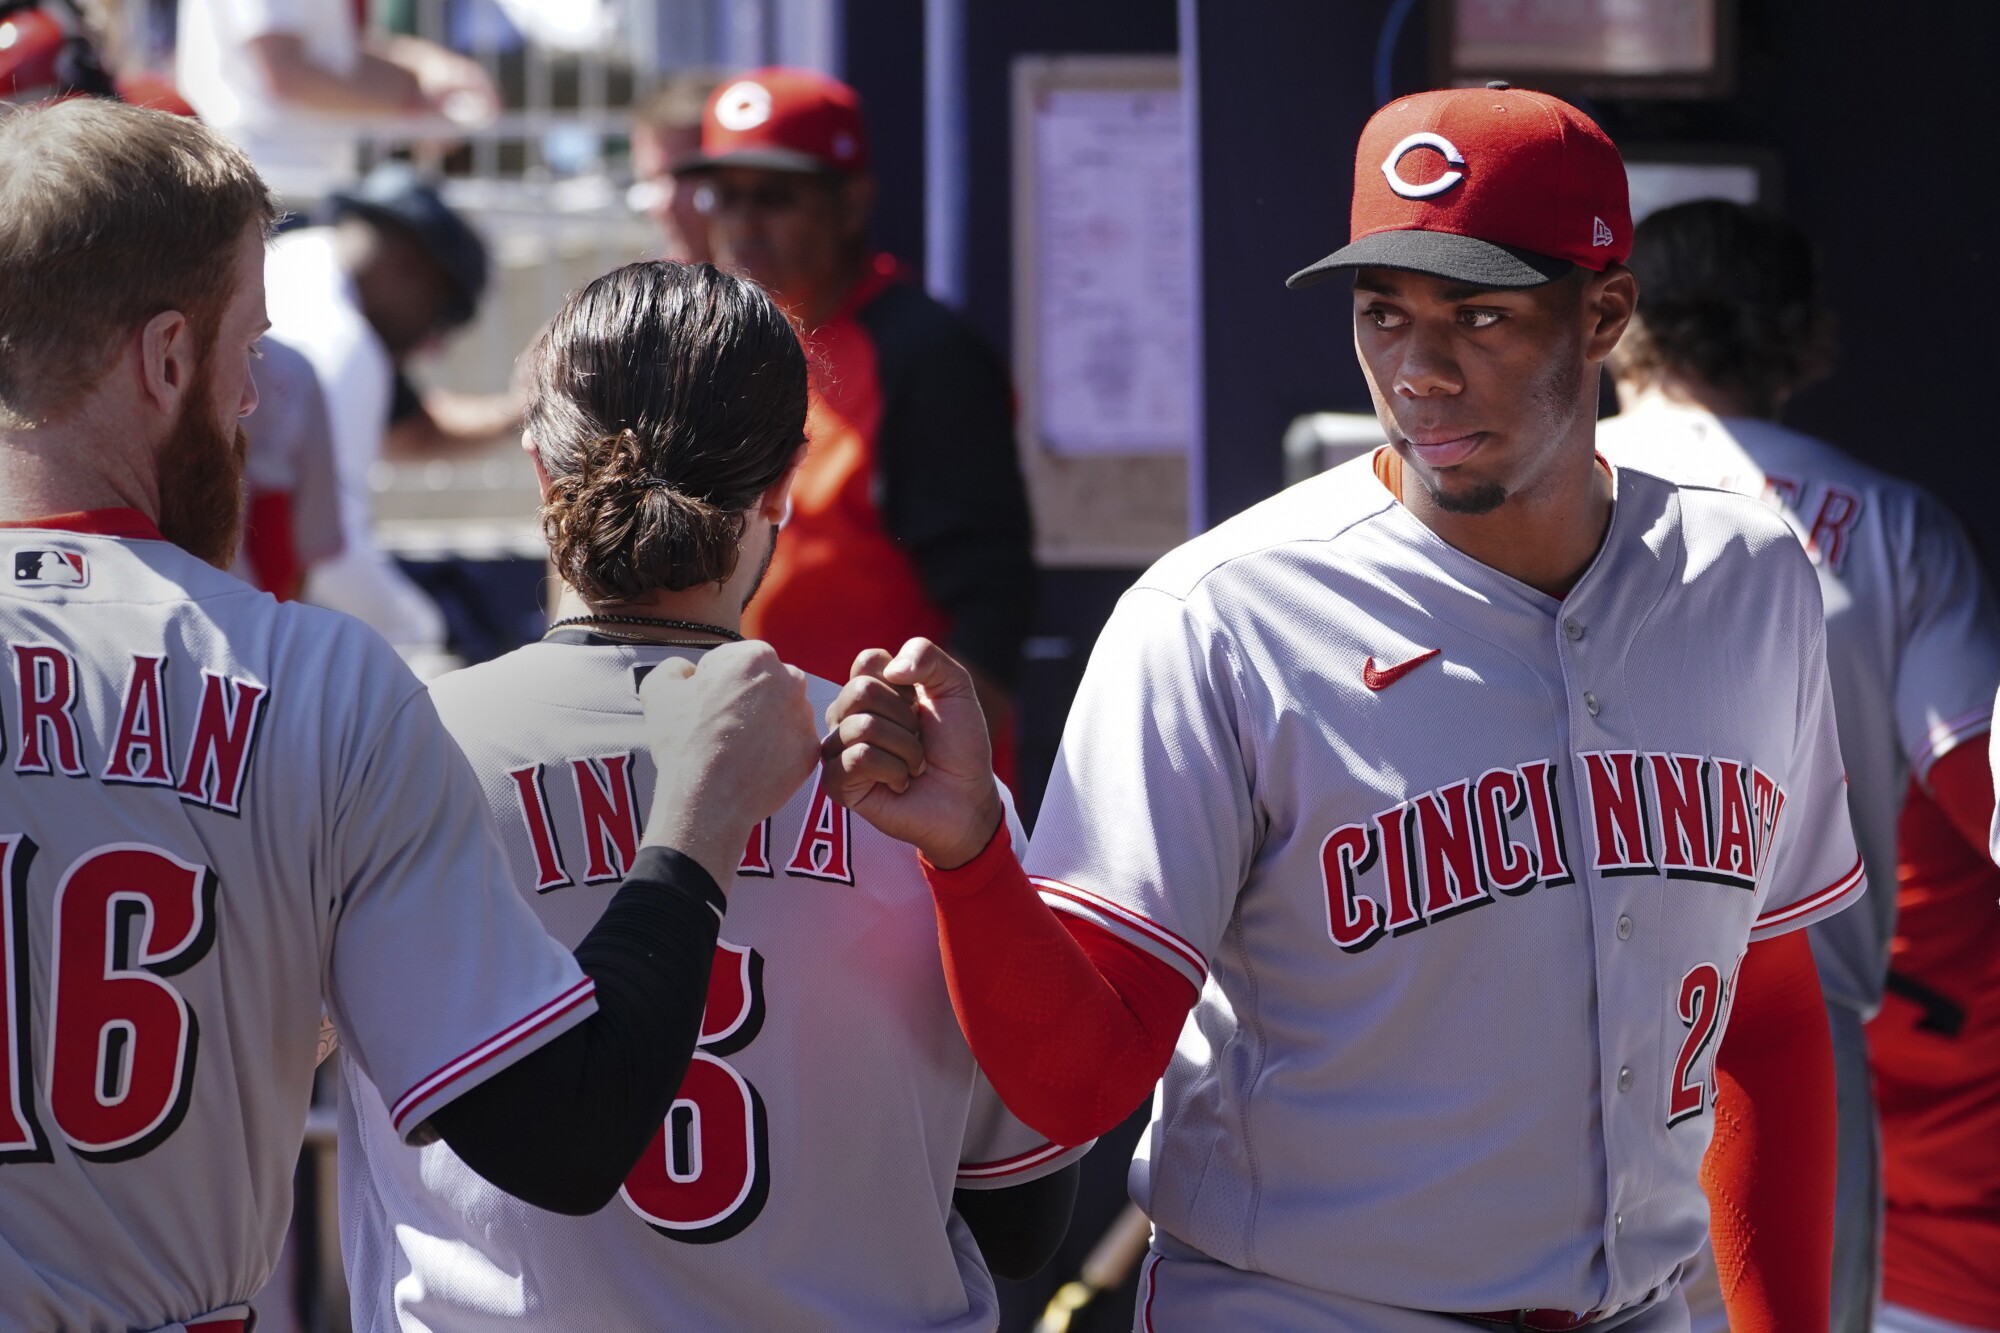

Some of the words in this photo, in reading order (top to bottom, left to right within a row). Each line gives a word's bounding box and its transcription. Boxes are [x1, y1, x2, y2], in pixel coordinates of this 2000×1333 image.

[1381, 132, 1466, 200] C
[0, 641, 271, 819] RAN
[505, 751, 855, 894] INA
[618, 937, 770, 1244] 6
[1666, 947, 1748, 1131] 2
